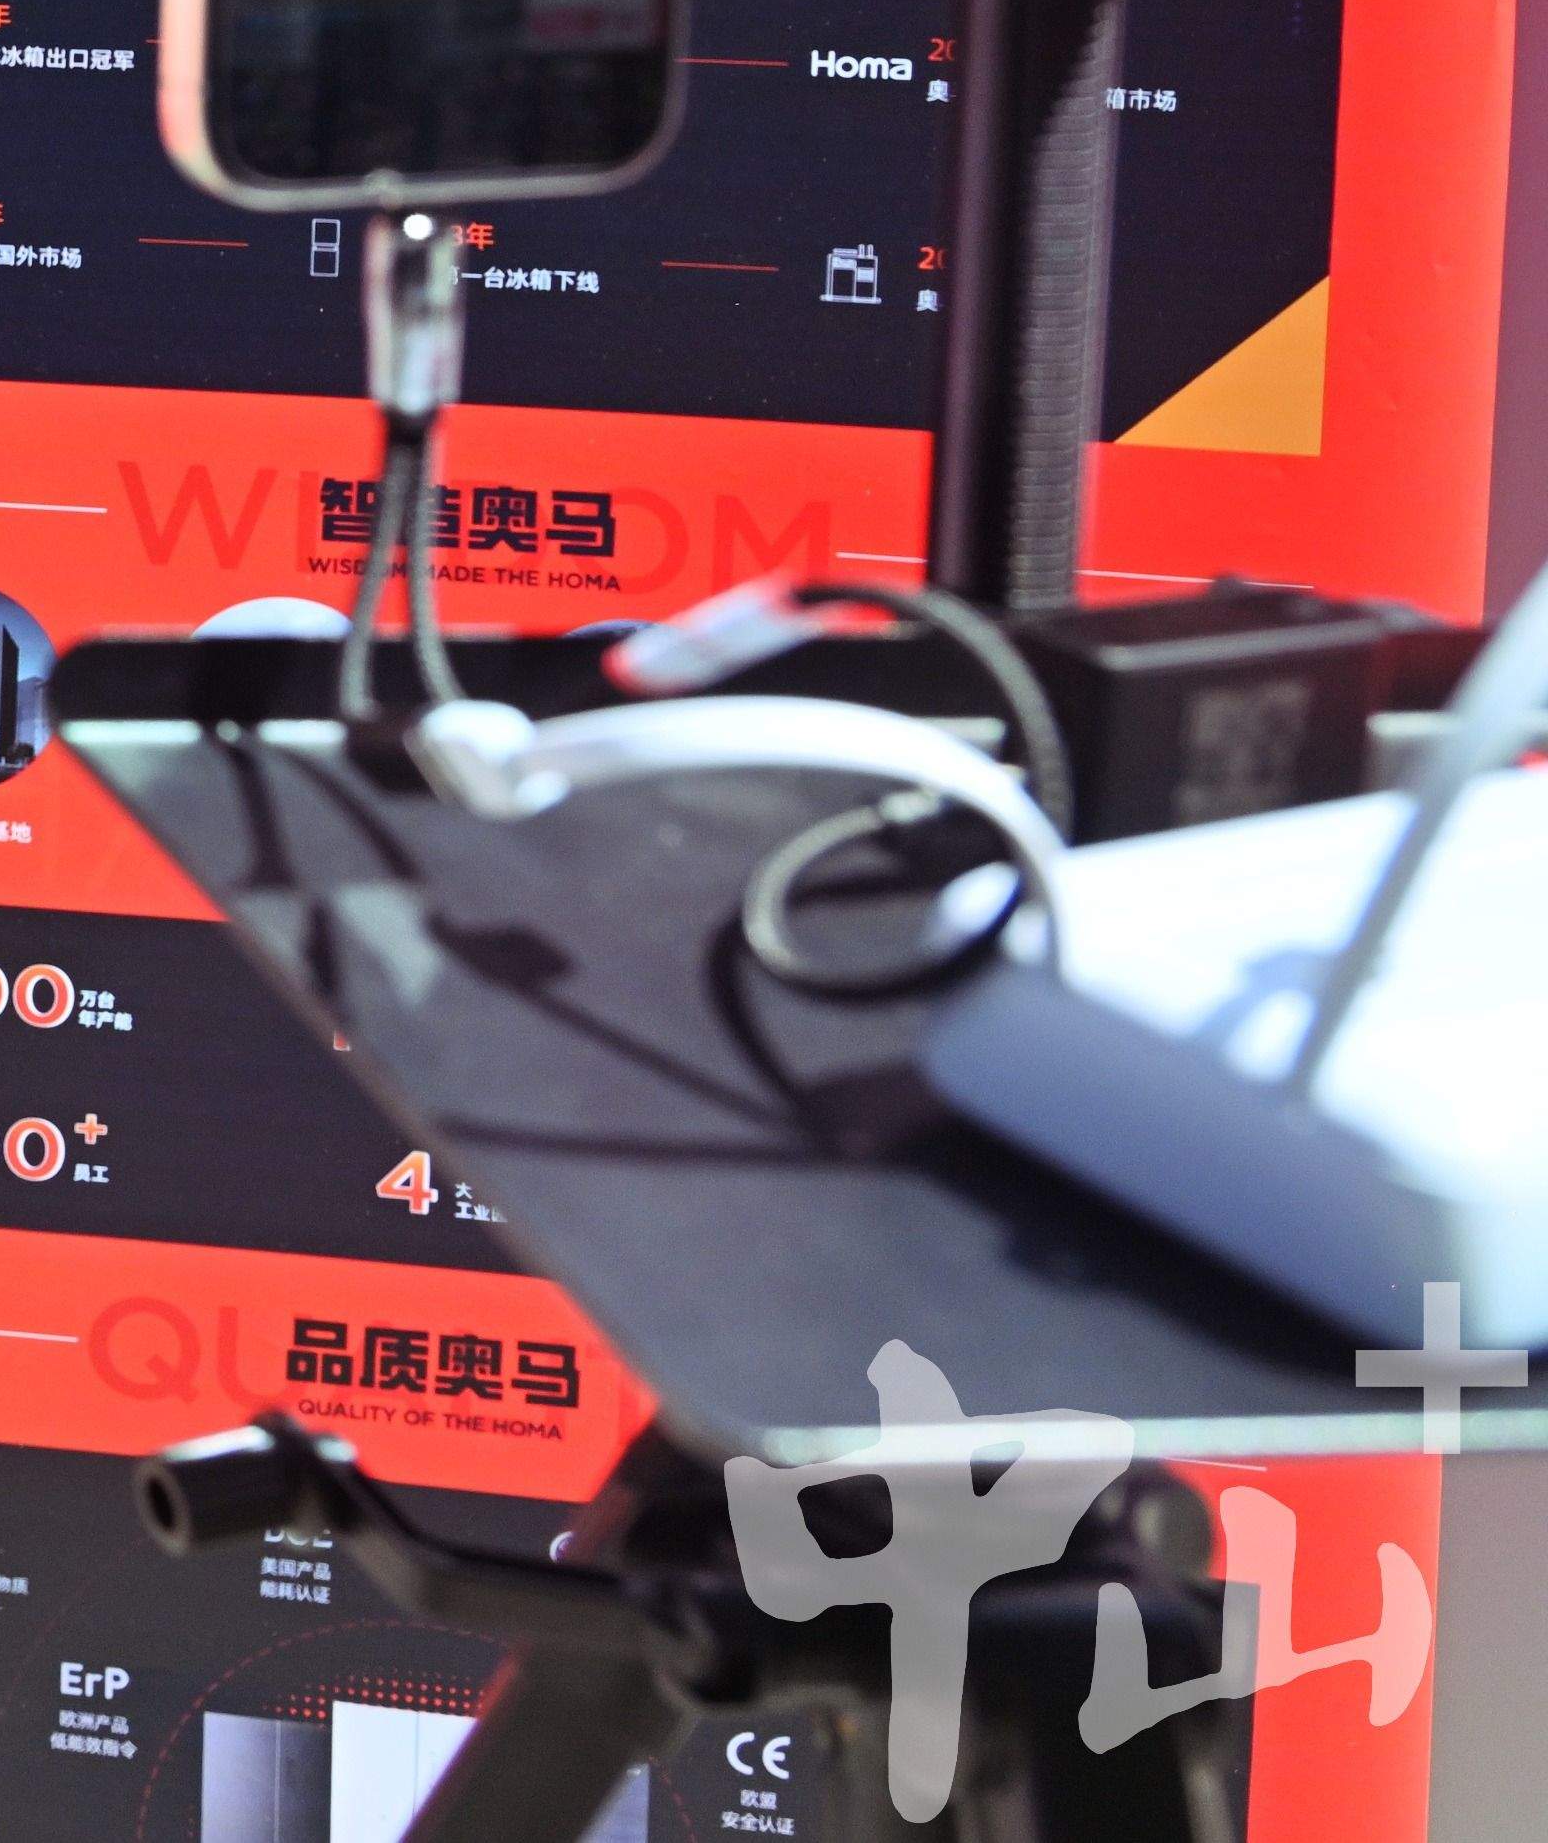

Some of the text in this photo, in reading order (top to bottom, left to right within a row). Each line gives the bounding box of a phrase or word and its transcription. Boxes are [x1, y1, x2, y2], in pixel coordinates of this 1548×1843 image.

[810, 50, 913, 81] Homa
[495, 567, 539, 586] THE
[548, 572, 621, 592] HOMA
[375, 1150, 439, 1216] 4
[286, 1318, 581, 1409] 品质奥马
[298, 1398, 563, 1440] QUALITY OF THE HOMA
[60, 1661, 131, 1701] ErP
[726, 1731, 792, 1780] CE
